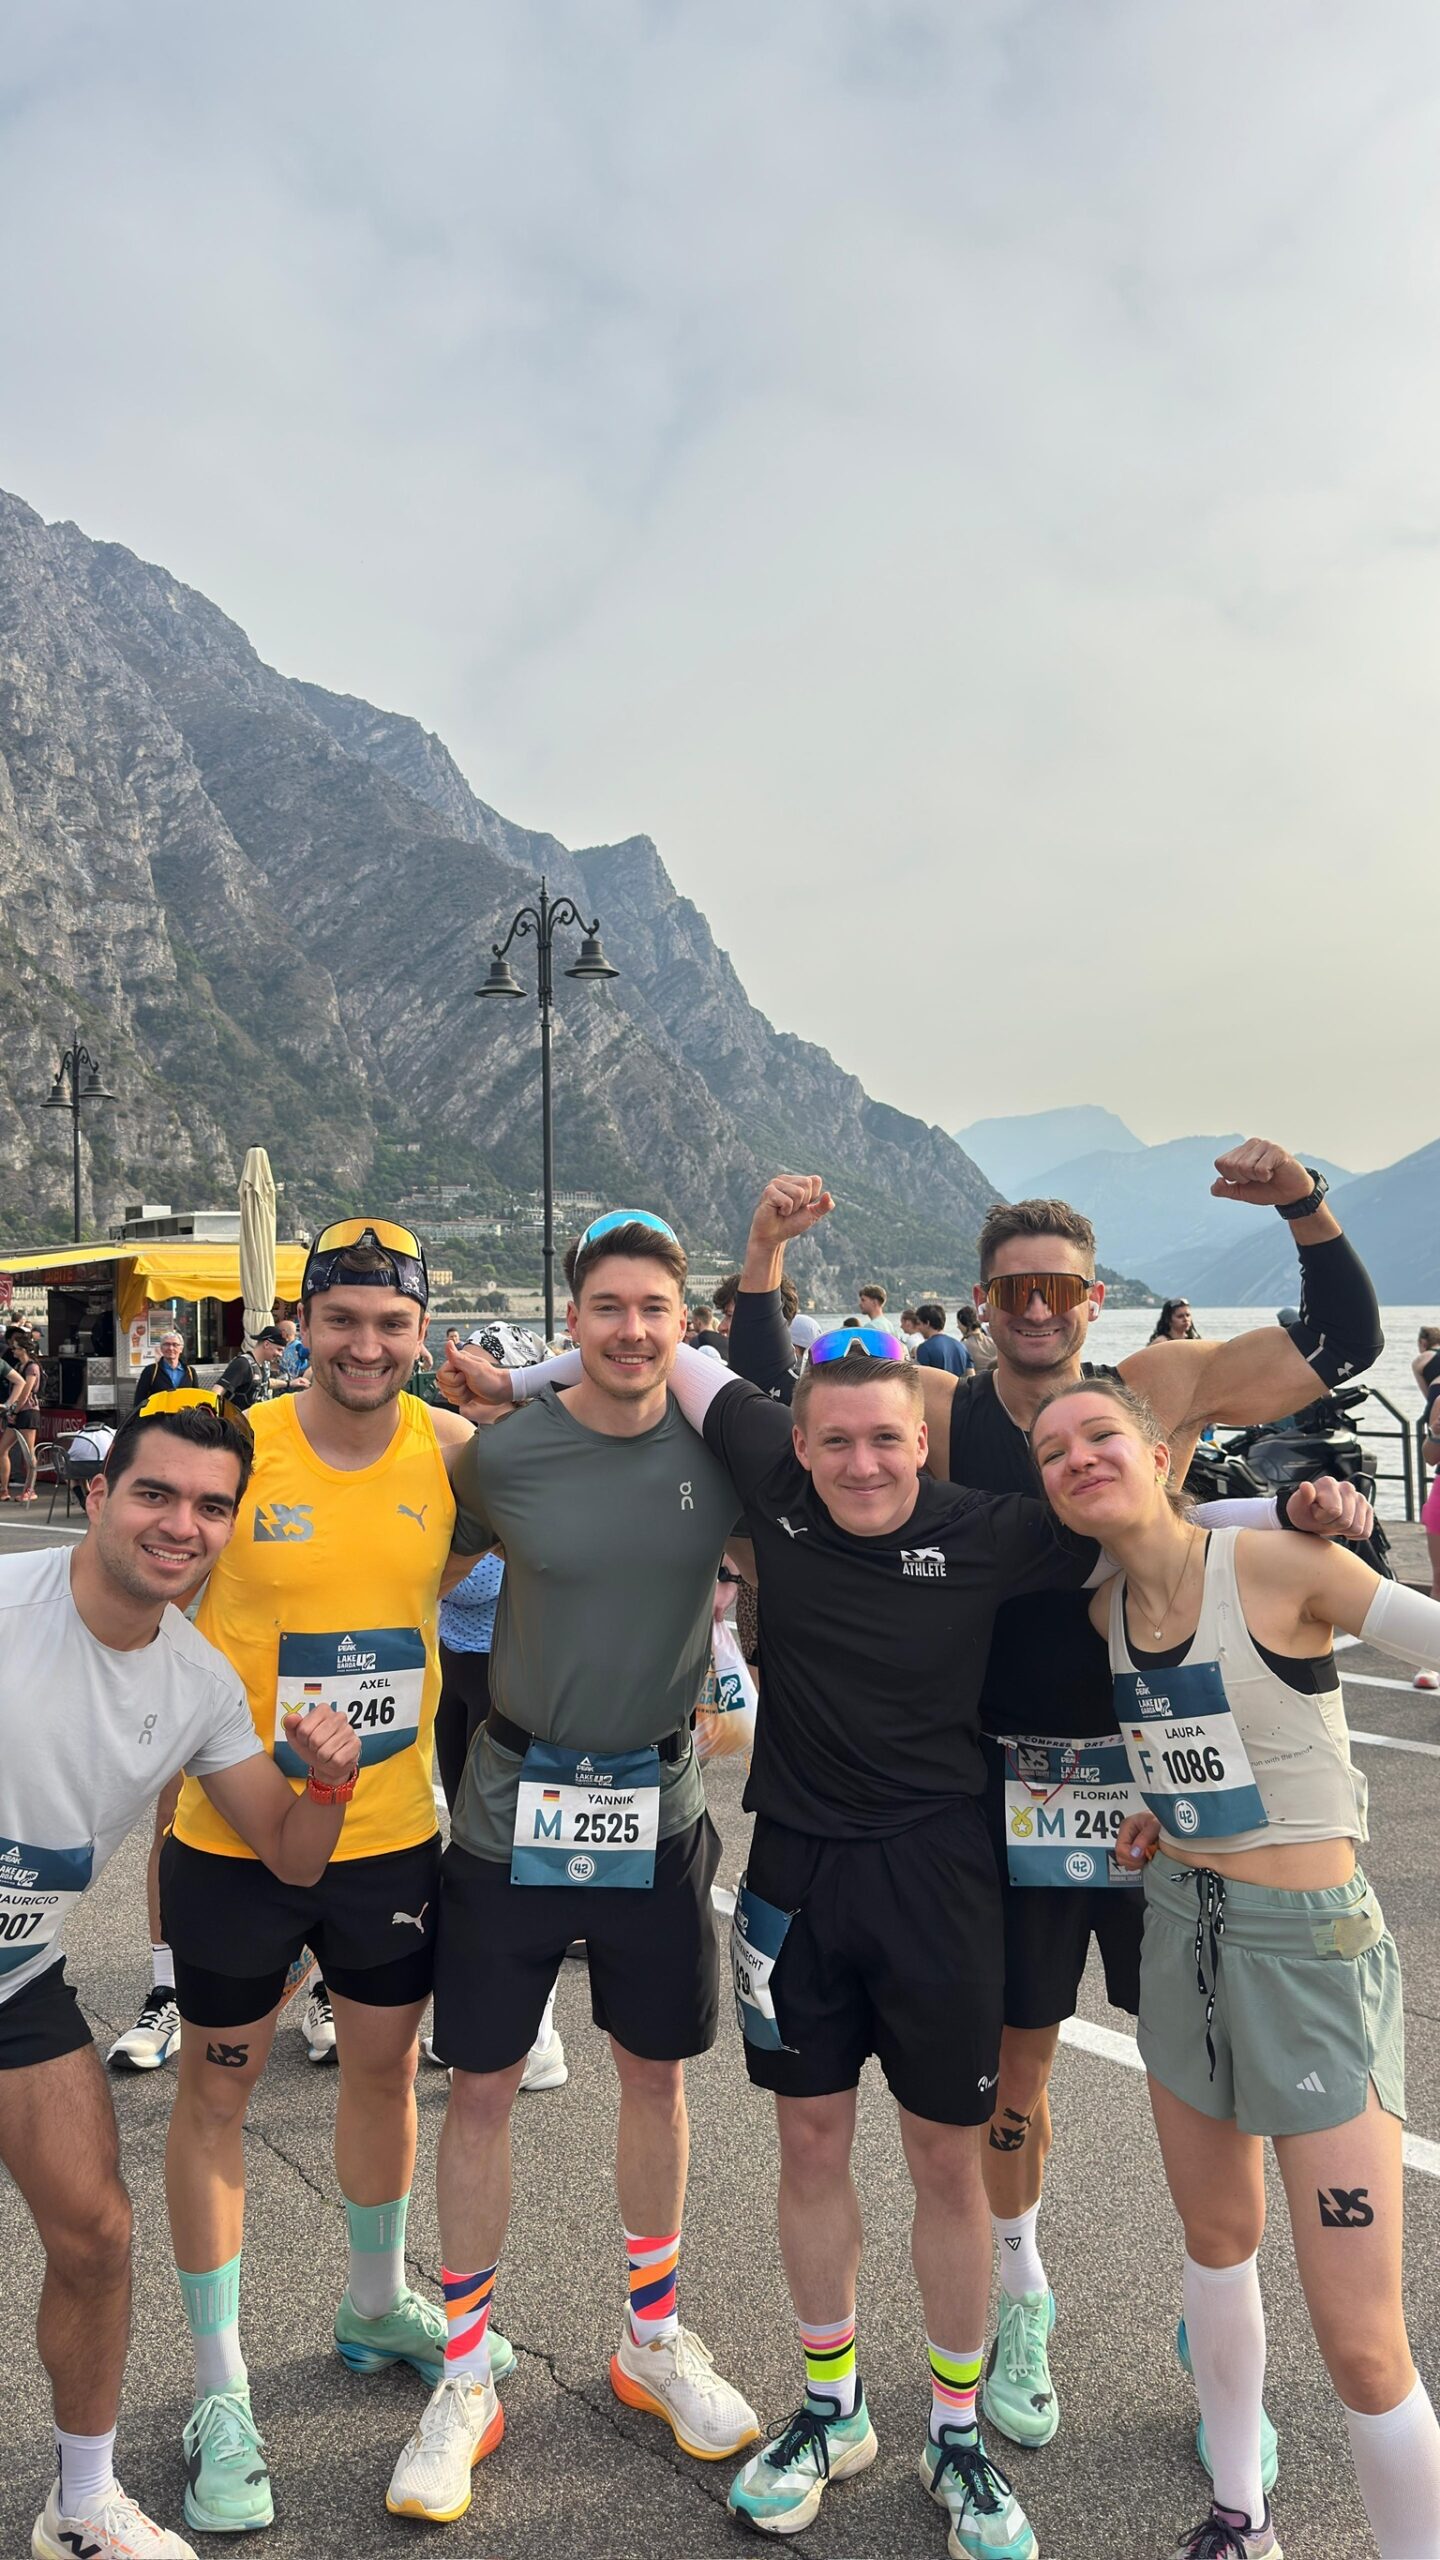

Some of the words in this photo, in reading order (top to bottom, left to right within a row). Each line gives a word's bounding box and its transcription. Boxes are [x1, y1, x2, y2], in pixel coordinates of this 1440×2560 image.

[902, 1562, 947, 1577] ATHLETE
[337, 1644, 357, 1652] PEAK
[337, 1654, 357, 1663] LAKE
[359, 1678, 391, 1691] AXEL
[1138, 1698, 1154, 1708] LAKE
[347, 1696, 396, 1730] 246
[1164, 1725, 1206, 1740] LAURA
[1138, 1750, 1154, 1785] F
[1162, 1746, 1225, 1785] 1086
[587, 1793, 634, 1805] YANNIK
[1073, 1790, 1129, 1800] FLORIAN
[1037, 1808, 1065, 1838] M
[1179, 1810, 1193, 1824] 42
[533, 1809, 563, 1841] M
[573, 1813, 639, 1844] 2525
[574, 1863, 589, 1874] 42
[1073, 1861, 1088, 1873] 42
